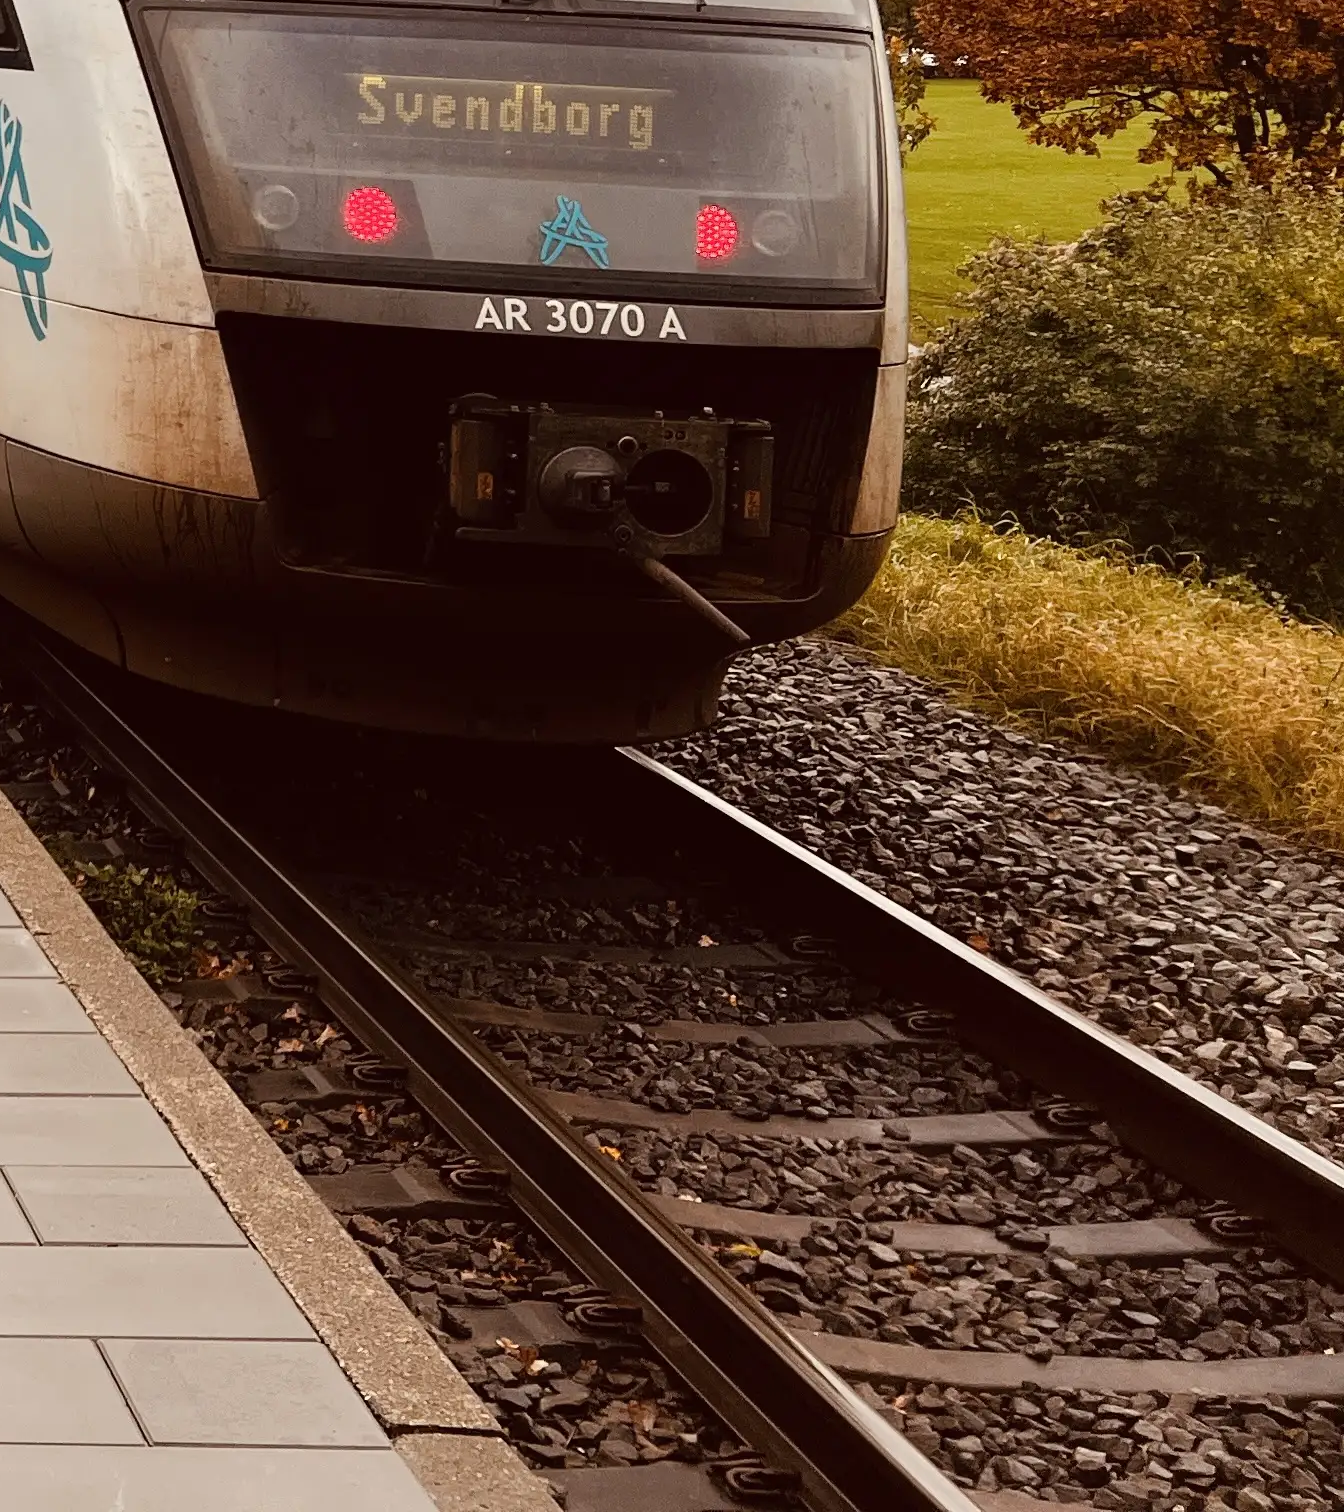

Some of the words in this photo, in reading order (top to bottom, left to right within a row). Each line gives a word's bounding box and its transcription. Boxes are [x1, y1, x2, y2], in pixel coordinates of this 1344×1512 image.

[357, 75, 654, 151] Svendborg
[474, 296, 532, 332] AR
[544, 298, 646, 338] 3070
[658, 306, 687, 341] A
